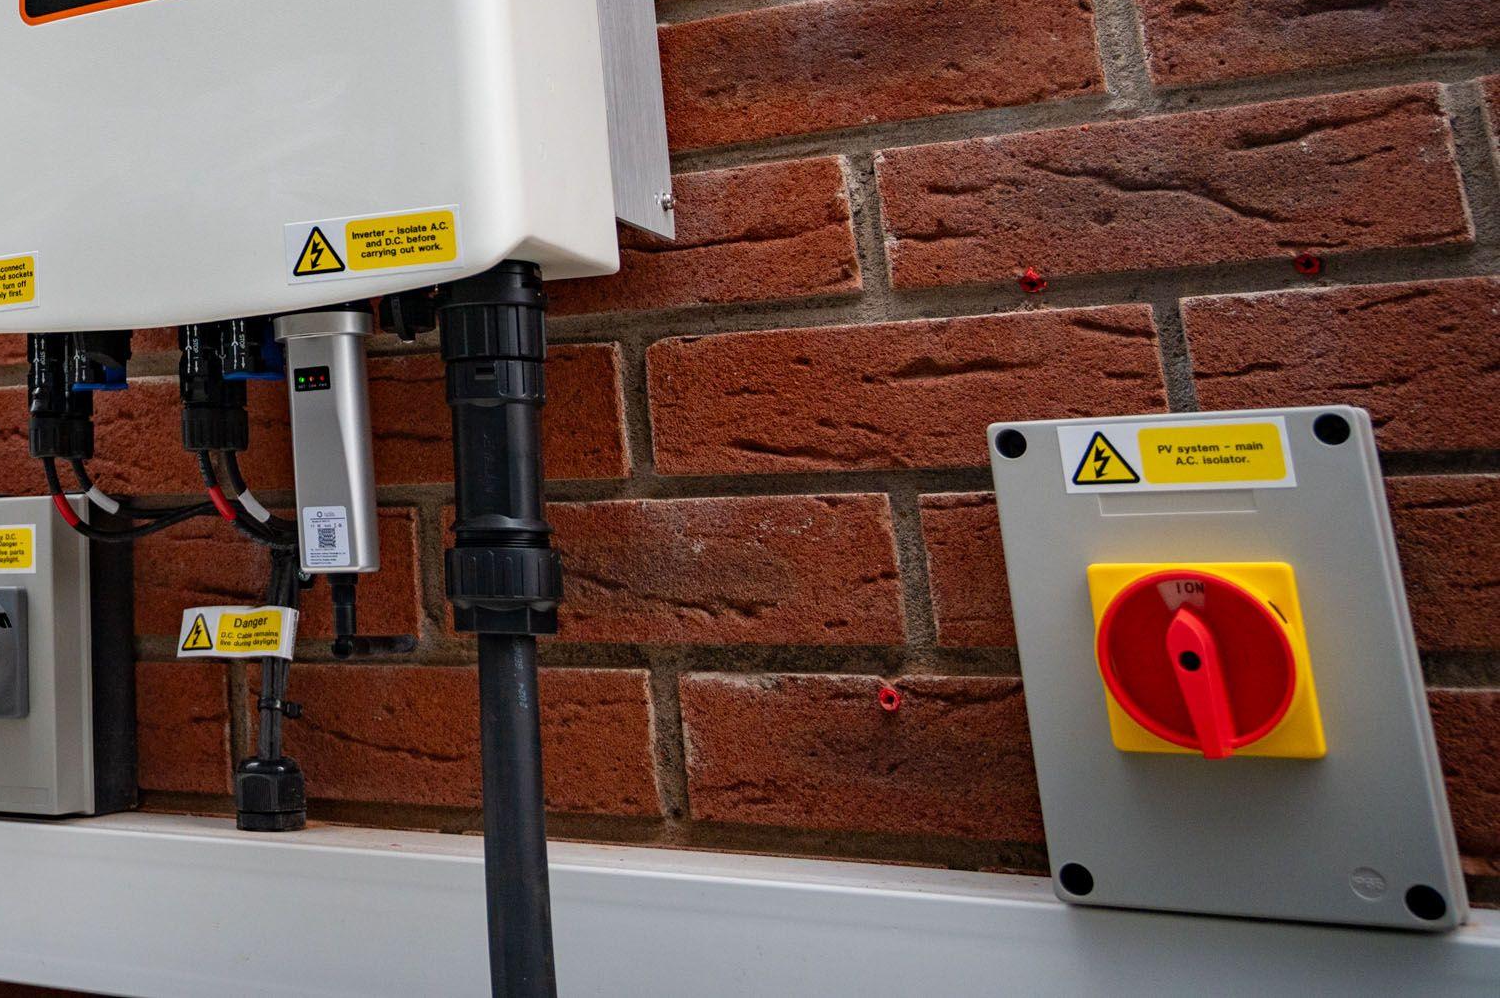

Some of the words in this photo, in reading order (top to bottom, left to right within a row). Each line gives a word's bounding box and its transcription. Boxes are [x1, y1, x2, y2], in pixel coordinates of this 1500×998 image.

[352, 230, 385, 240] Inverter
[430, 222, 449, 230] A.C.
[366, 239, 382, 248] and
[385, 238, 403, 246] D.C.
[406, 234, 436, 243] before
[361, 248, 396, 258] carrying
[418, 243, 443, 252] work.
[8, 271, 33, 280] sockets
[1158, 444, 1172, 454] PV
[1178, 444, 1219, 454] system
[1235, 442, 1263, 451] main
[1176, 456, 1198, 465] A.C.
[1203, 455, 1250, 464] isolator.
[1184, 582, 1204, 594] ON
[234, 617, 268, 628] Danger
